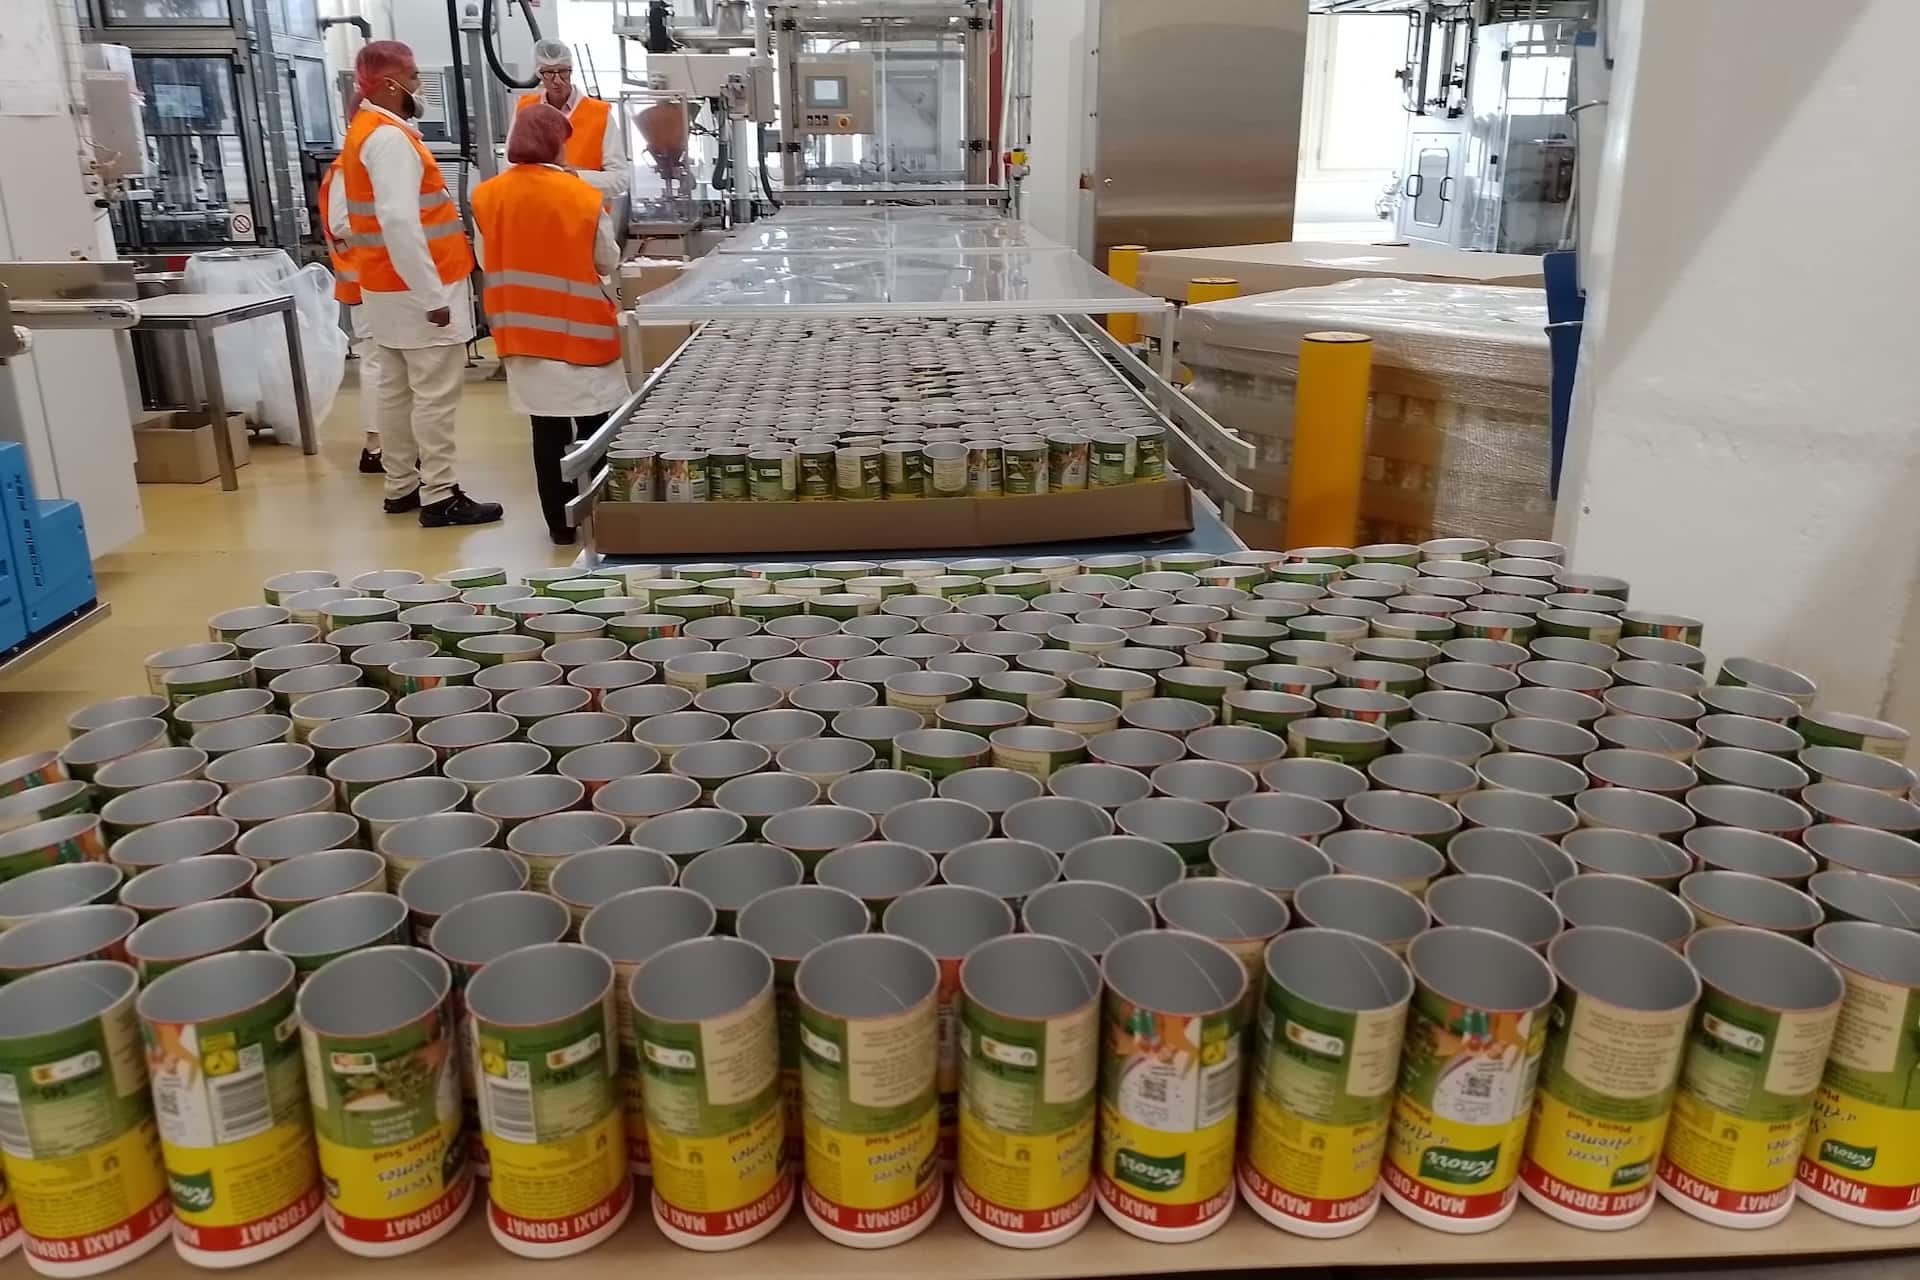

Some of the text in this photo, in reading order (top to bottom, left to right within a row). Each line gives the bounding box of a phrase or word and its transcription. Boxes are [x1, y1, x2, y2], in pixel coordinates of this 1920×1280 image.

[1118, 1152, 1182, 1187] Knorr
[1425, 1151, 1496, 1178] Knorr
[1823, 1142, 1873, 1168] Knorr
[1271, 1186, 1312, 1217] MAXI
[1424, 1189, 1466, 1215] MAXI
[1540, 1176, 1608, 1211] FORMAT
[1612, 1189, 1646, 1211] MAXI
[1676, 1173, 1720, 1205] MAXI
[1822, 1173, 1867, 1203] MAXI
[383, 1197, 450, 1239] FORMAT
[505, 1202, 611, 1240] MAXI FORMAT
[671, 1212, 707, 1233] MAXI
[854, 1200, 917, 1229] FORMAT
[985, 1203, 1024, 1230] MAXI
[1120, 1194, 1158, 1222] MAXI
[83, 1225, 131, 1255] MAXI
[239, 1205, 306, 1246] FORMAT
